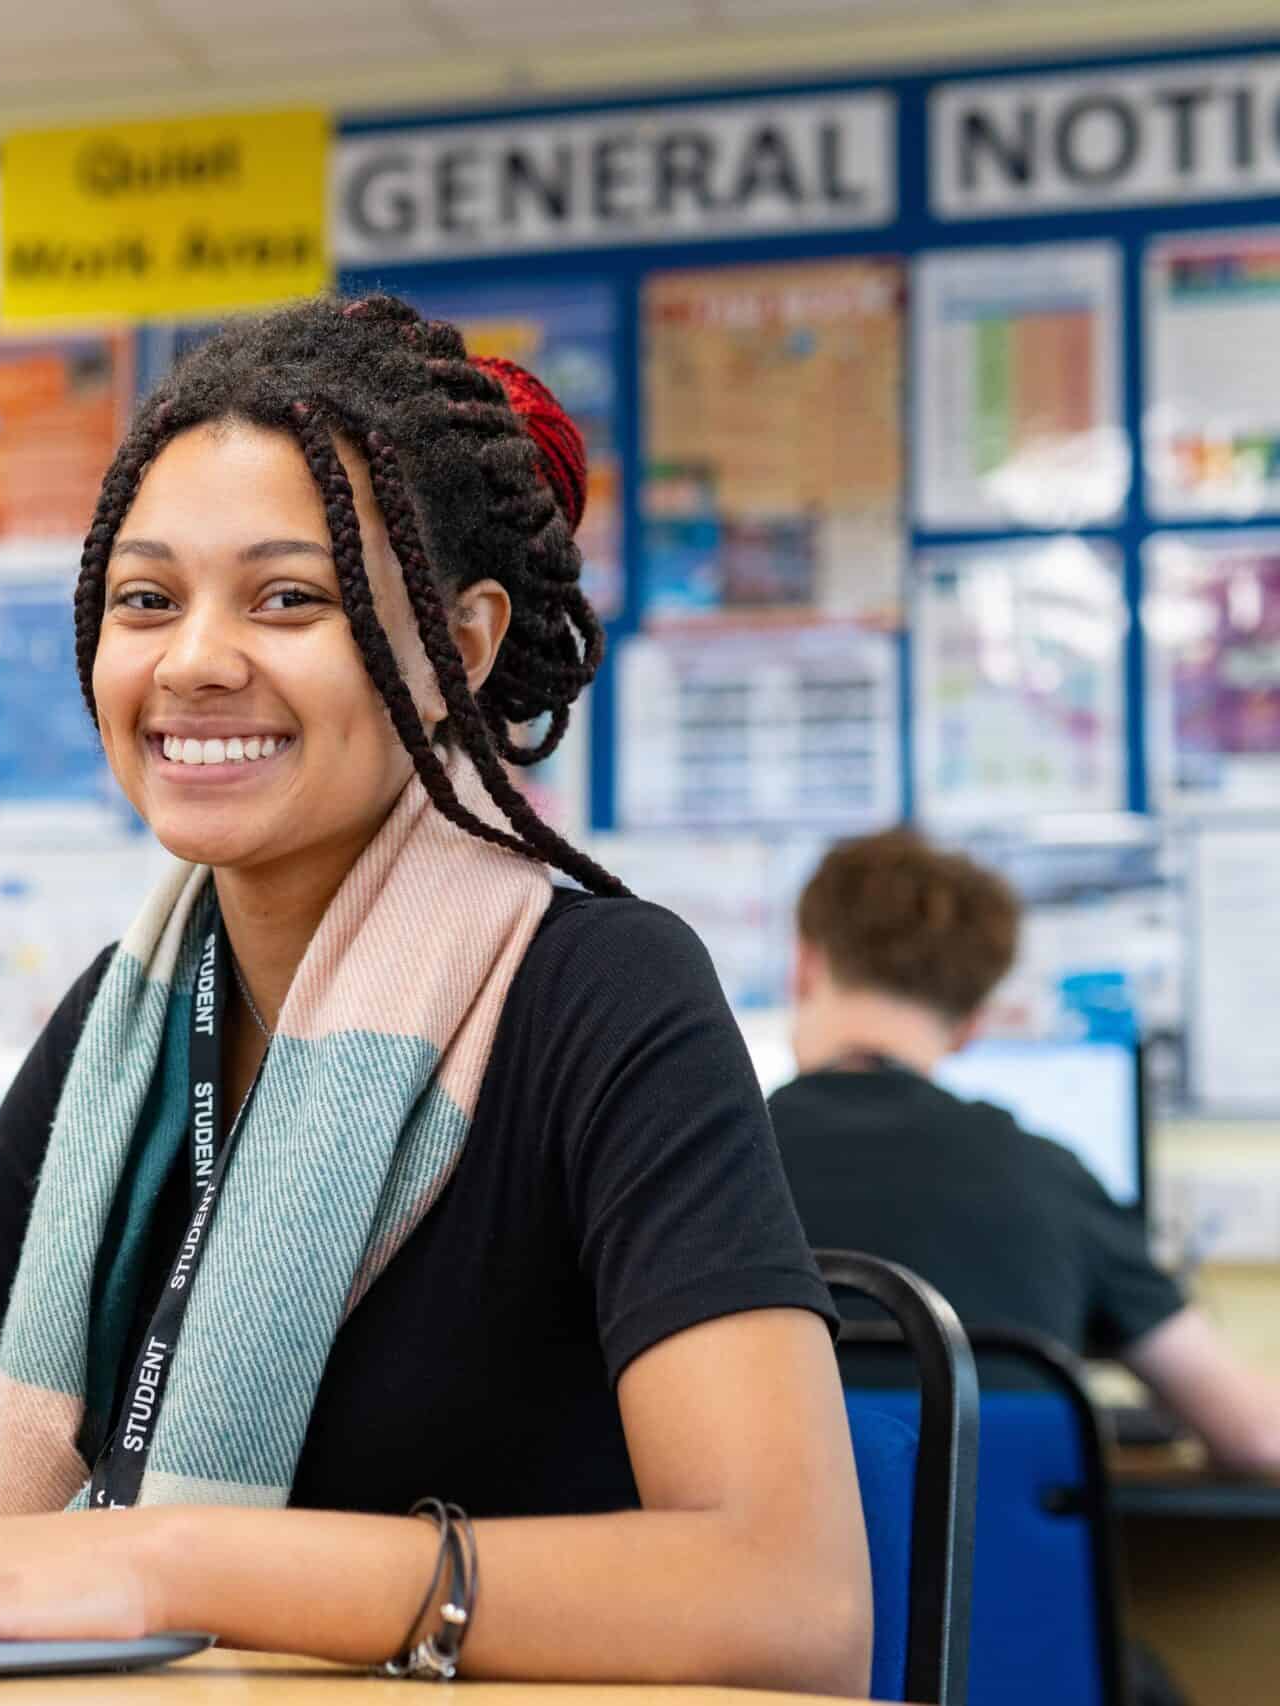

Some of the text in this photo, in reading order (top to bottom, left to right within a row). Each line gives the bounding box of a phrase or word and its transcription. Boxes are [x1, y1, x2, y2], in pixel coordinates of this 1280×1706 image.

[78, 138, 242, 199] Quiet
[341, 84, 1280, 244] GENERAL NOTI
[10, 224, 318, 280] Work Area
[195, 933, 215, 1036] STUDENT
[170, 1183, 215, 1290] STUDENT
[122, 1335, 168, 1452] STUDENT
